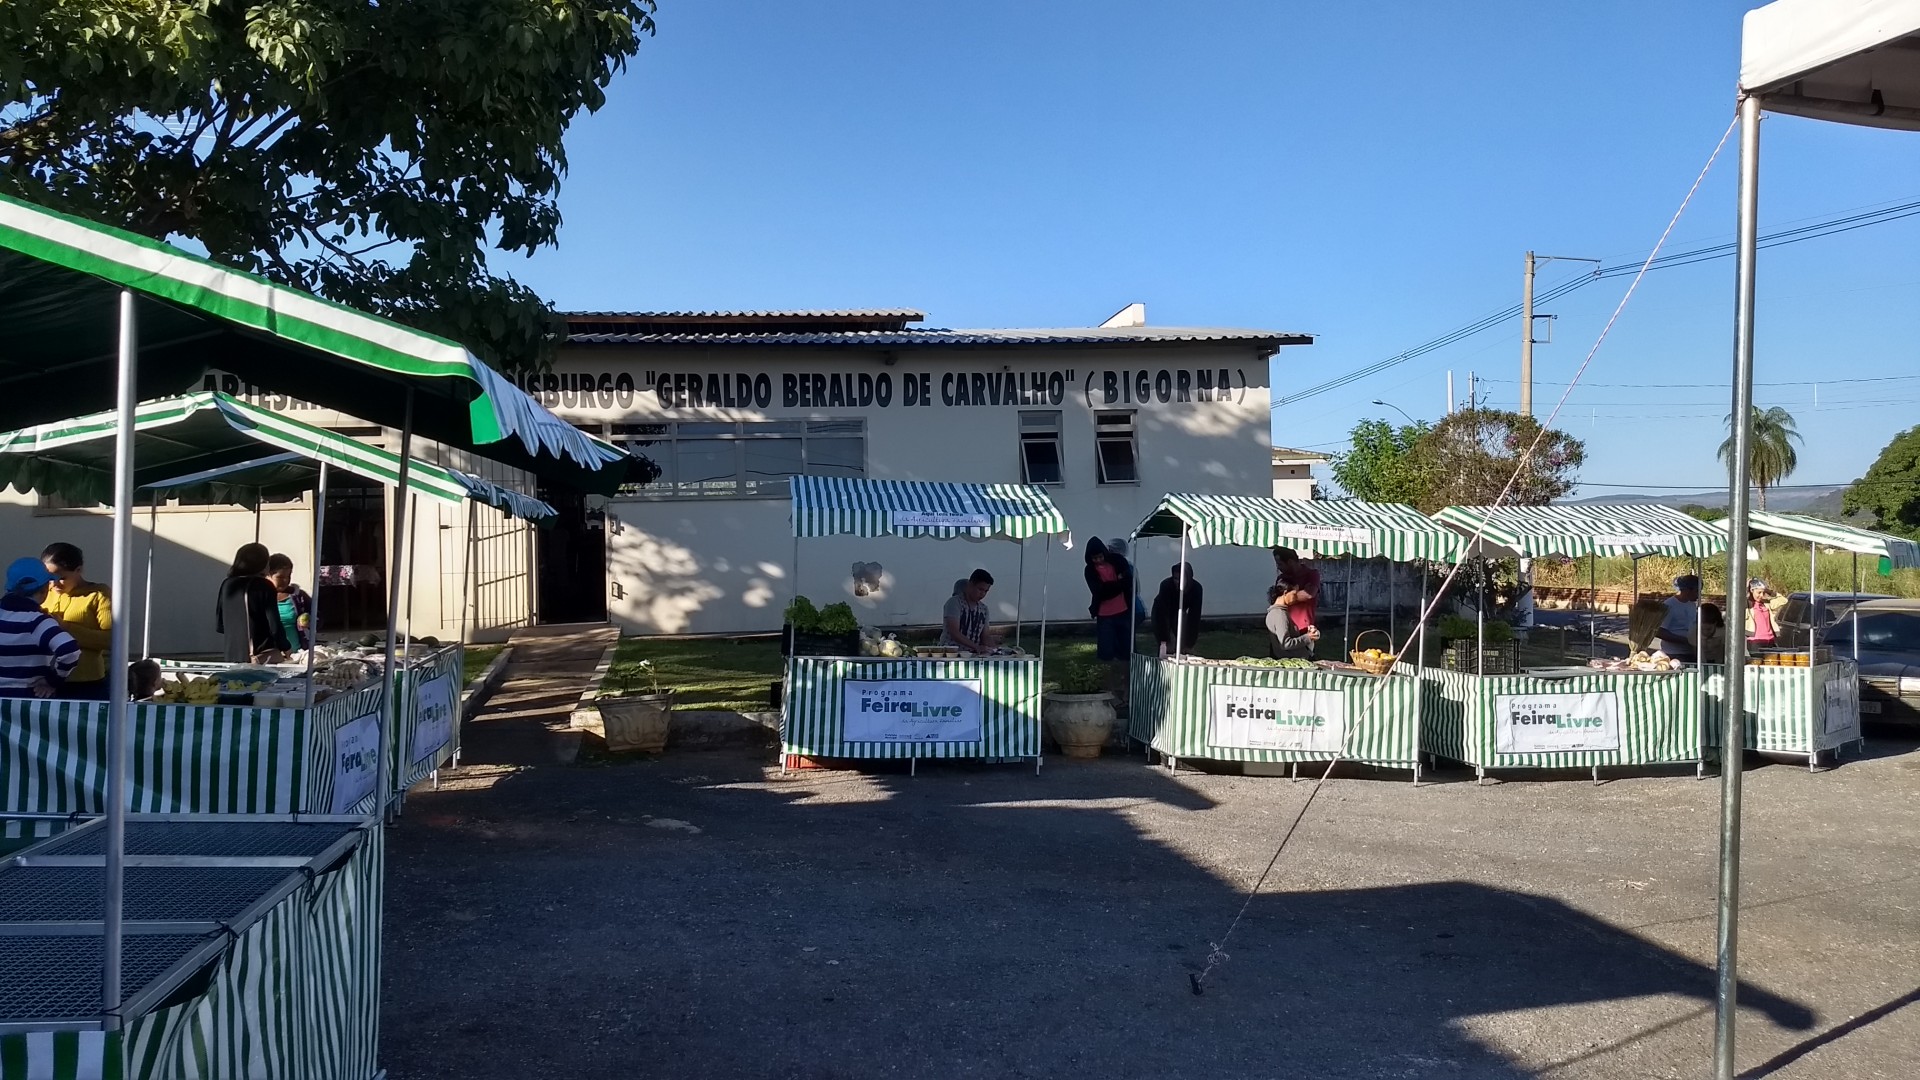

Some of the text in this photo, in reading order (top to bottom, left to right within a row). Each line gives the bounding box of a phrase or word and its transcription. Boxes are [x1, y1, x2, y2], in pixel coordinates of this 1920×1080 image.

[646, 371, 772, 409] "GERALDO
[782, 372, 893, 408] BERALDO
[903, 372, 932, 407] DE
[940, 369, 1075, 406] CARVALHO"
[861, 689, 913, 697] Programa
[1226, 695, 1277, 704] Projeto
[1511, 703, 1557, 711] Programa
